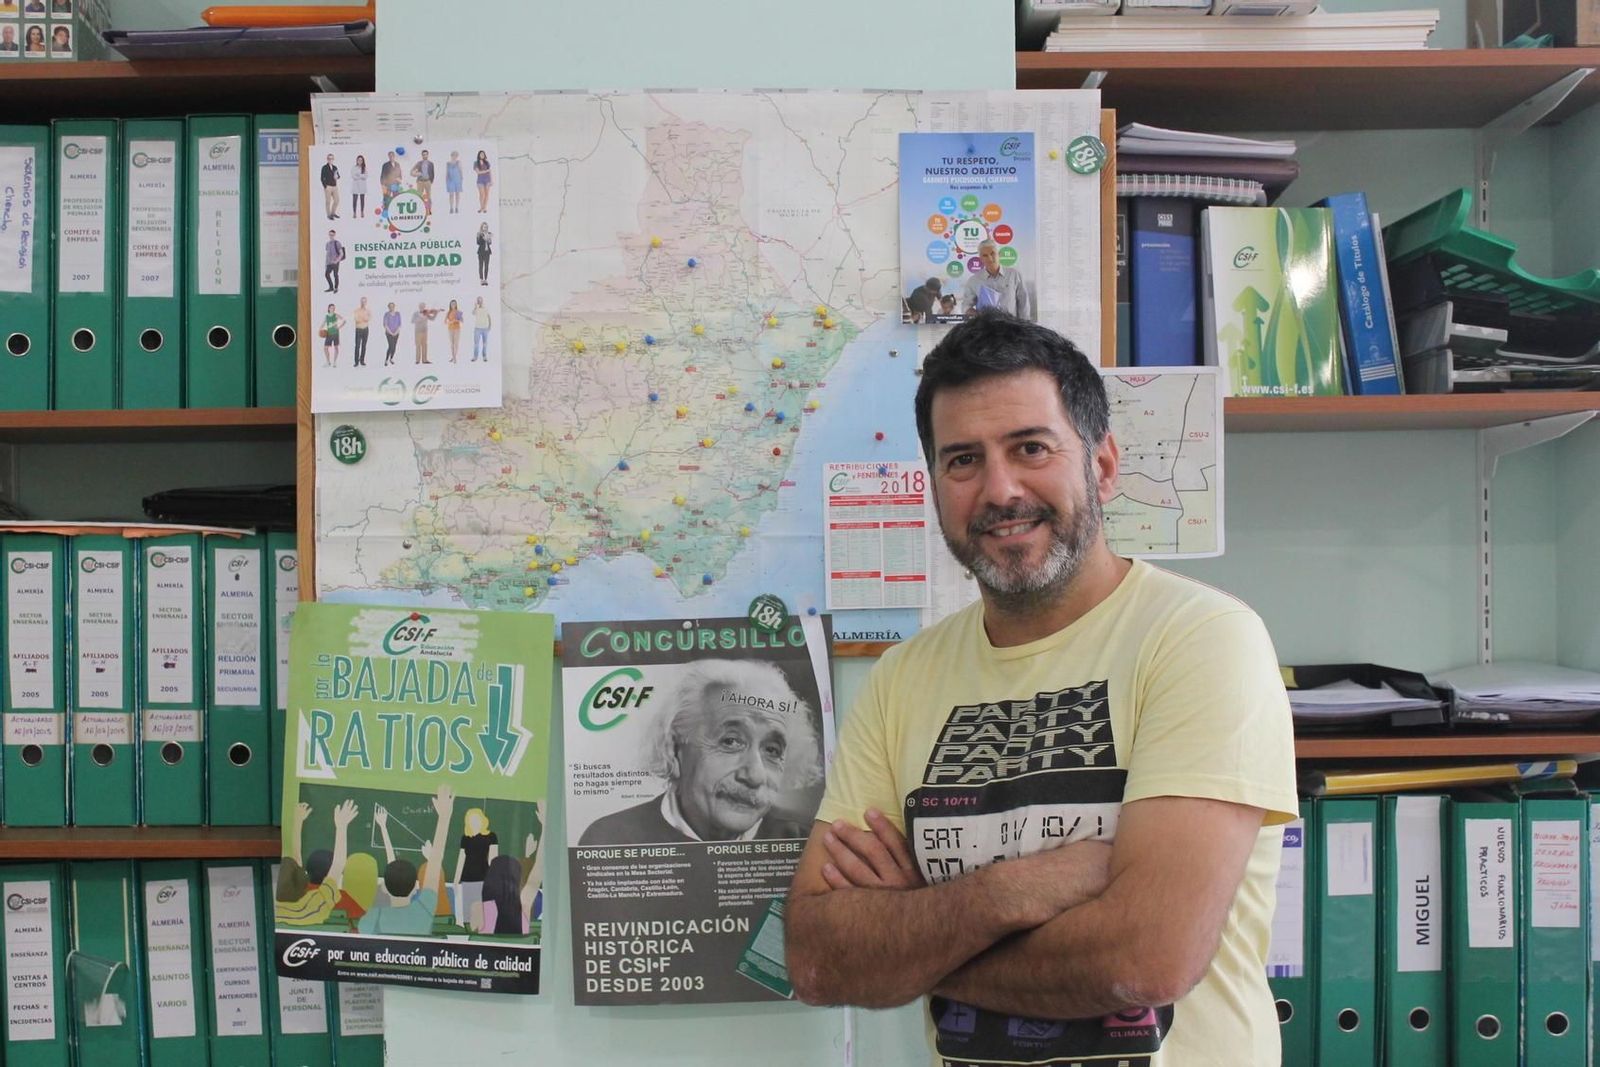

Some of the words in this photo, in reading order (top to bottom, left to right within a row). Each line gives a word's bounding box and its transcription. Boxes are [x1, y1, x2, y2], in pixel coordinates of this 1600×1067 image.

[268, 138, 298, 153] Uni
[942, 157, 953, 165] TU
[957, 157, 999, 165] RESPETO,
[1070, 140, 1098, 172] 18h
[971, 167, 1017, 175] OBJETIVO
[397, 199, 417, 214] TÚ
[22, 212, 33, 227] de
[963, 228, 979, 237] TU
[354, 240, 417, 251] ENSEÑANZA
[420, 239, 461, 249] PÚBLICA
[354, 256, 377, 269] DE
[384, 253, 462, 268] CALIDAD
[1357, 271, 1366, 284] de
[1360, 284, 1374, 329] Catálogo
[1242, 384, 1314, 395] www.csi-f.es
[334, 437, 363, 457] 18h
[881, 470, 925, 493] 2018
[221, 590, 253, 598] ALMERÍA
[751, 602, 782, 629] 18h
[832, 629, 901, 640] ALMERÍA
[218, 654, 256, 663] RELIGIÓN
[477, 662, 493, 682] de
[316, 676, 333, 699] por
[333, 655, 477, 706] BAJADA
[952, 682, 1104, 723] PARTY
[942, 701, 1104, 743] PARTY
[309, 709, 474, 774] RATIOS
[934, 722, 1107, 763] PARTY
[926, 745, 1110, 784] PARTY
[573, 771, 614, 779] resultados
[616, 770, 652, 778] distintos,
[586, 781, 609, 789] hagas
[611, 780, 642, 788] siempre
[922, 798, 938, 806] SC
[943, 797, 978, 806] 10/11
[707, 845, 752, 855] PORQUE
[755, 844, 768, 853] SE
[1497, 826, 1505, 863] NUEVOS
[577, 850, 622, 859] PORQUE
[624, 848, 638, 858] SE
[641, 848, 685, 857] PUEDE...
[1416, 875, 1430, 945] MIGUEL
[1498, 874, 1507, 940] FUNCIONARIOS
[151, 919, 184, 927] ALMERÍA
[584, 914, 749, 937] REIVINDICACIÓN
[214, 946, 255, 954] ENSEÑANZA
[584, 938, 694, 956] HISTÓRICA
[328, 950, 344, 962] por
[351, 952, 369, 962] una
[375, 949, 426, 966] educación
[432, 950, 469, 969] pública
[474, 954, 488, 970] de
[495, 957, 532, 972] calidad
[586, 959, 611, 974] DE
[586, 978, 653, 992] DESDE
[660, 976, 705, 992] 2003
[283, 1004, 322, 1012] PERSONAL
[1110, 1030, 1150, 1038] CLIMAX
